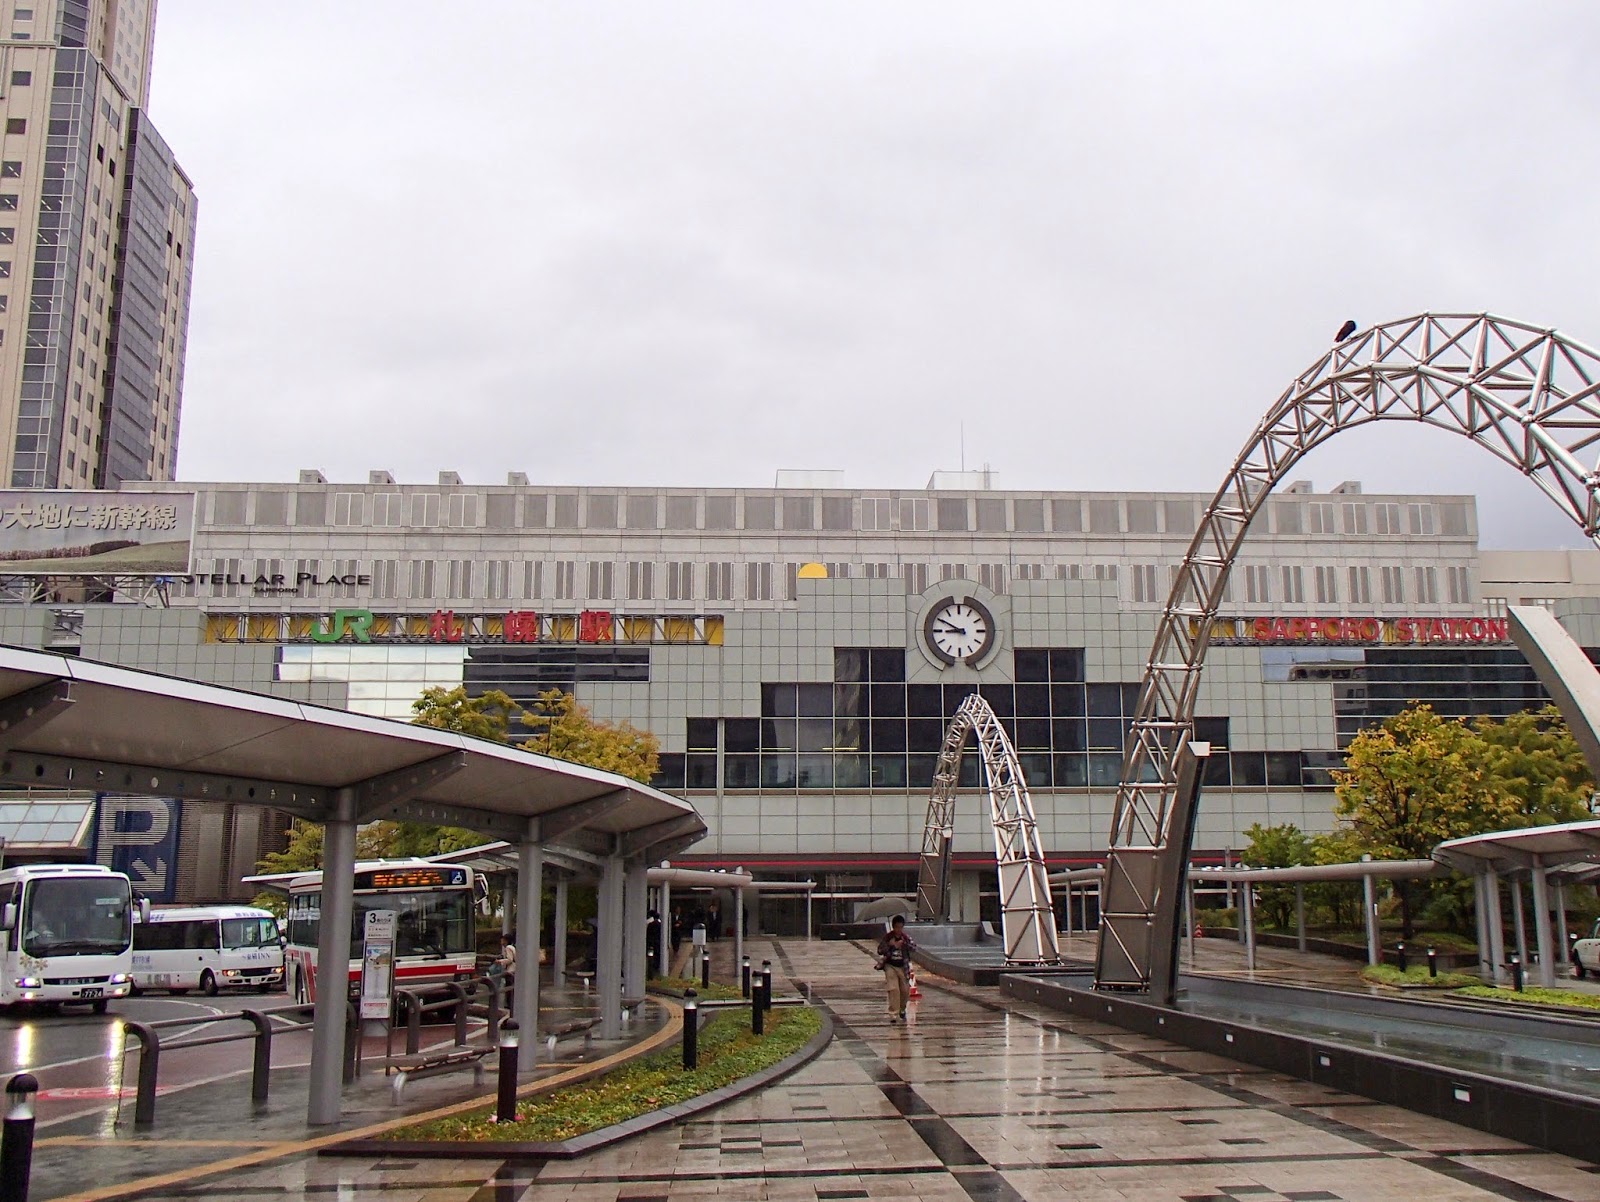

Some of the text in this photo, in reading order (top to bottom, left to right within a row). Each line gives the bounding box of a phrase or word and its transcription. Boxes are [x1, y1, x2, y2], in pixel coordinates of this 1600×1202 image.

[297, 572, 371, 586] PLACE
[311, 609, 612, 642] JR 札幌駅
[1253, 617, 1509, 641] SAPPORO STATION
